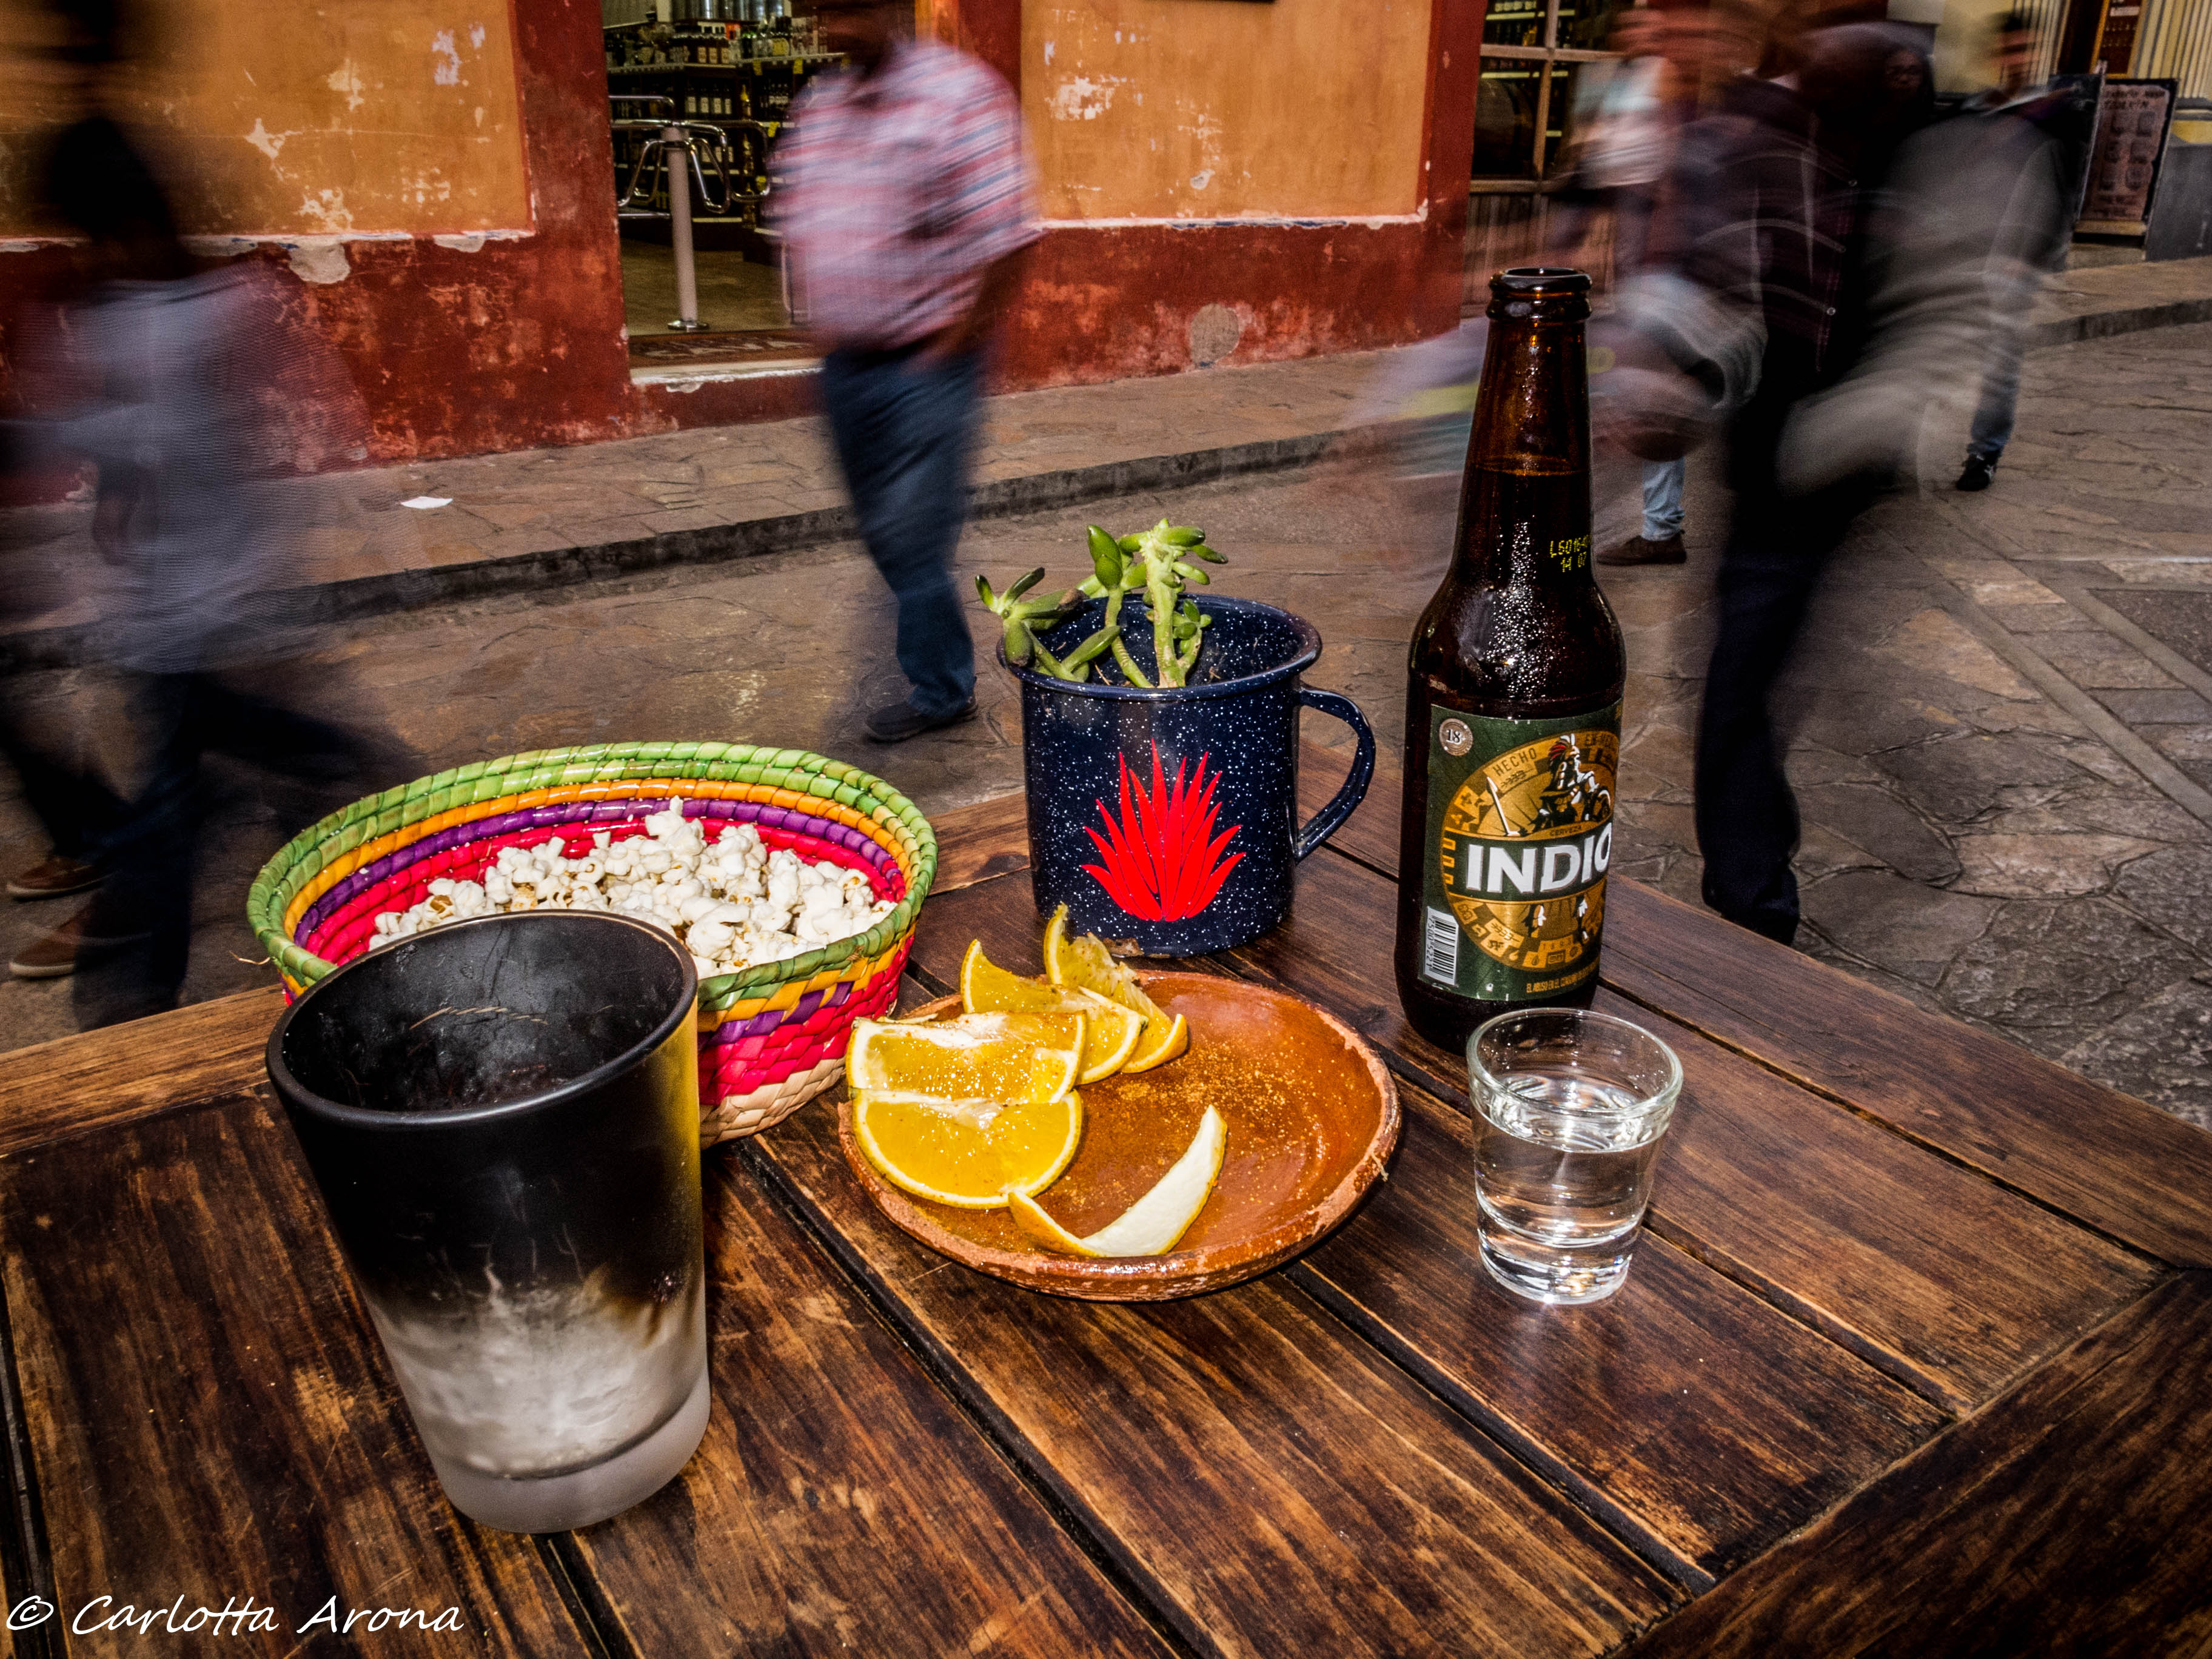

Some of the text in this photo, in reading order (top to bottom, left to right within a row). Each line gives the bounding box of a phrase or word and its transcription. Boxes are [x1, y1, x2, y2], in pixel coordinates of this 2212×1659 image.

[1493, 748, 1537, 777] HECHO
[1550, 826, 1581, 836] CERVEZA
[1466, 822, 1612, 894] INDIO
